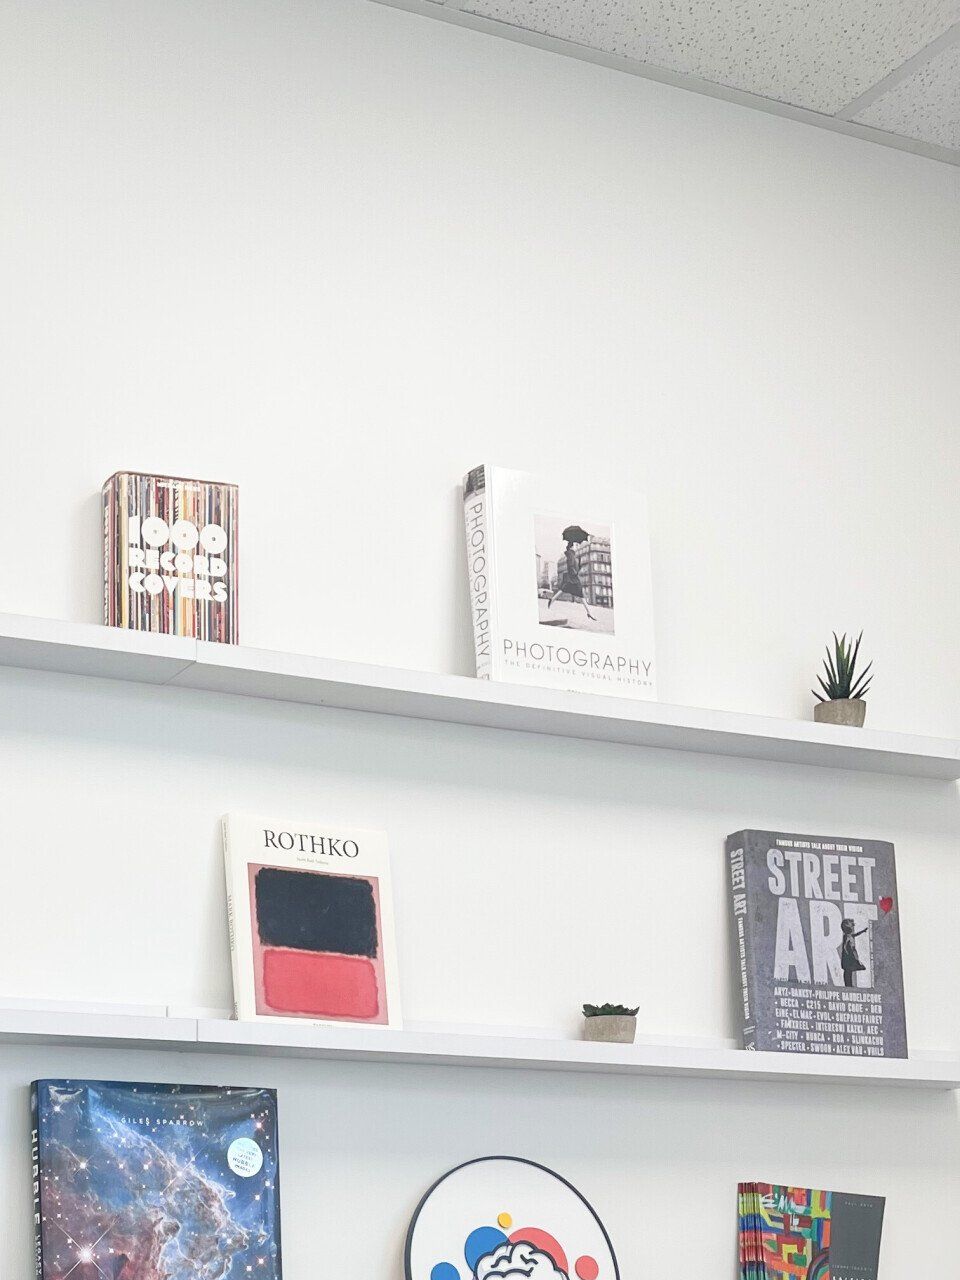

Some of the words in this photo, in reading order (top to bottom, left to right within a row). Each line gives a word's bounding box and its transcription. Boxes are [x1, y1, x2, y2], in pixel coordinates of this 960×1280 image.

[128, 515, 228, 555] 1000
[128, 547, 228, 578] RECORD
[128, 571, 228, 603] COVERS
[469, 502, 491, 657] PHOTOGRAPHY
[503, 638, 652, 677] PHOTOGRAPHY
[504, 659, 521, 668] THE
[525, 662, 577, 676] DEFINITIVE
[581, 671, 612, 681] VISUAL
[617, 676, 653, 687] HISTORY
[263, 829, 359, 858] ROTHKO
[730, 848, 746, 891] STREET
[766, 848, 876, 903] STREET
[733, 893, 748, 916] ART
[773, 896, 879, 989] ART
[805, 999, 821, 1010] C215
[828, 1001, 846, 1012] DAVID
[814, 989, 840, 1001] PHILIPPE
[835, 1012, 863, 1023] SHEPARD
[863, 1014, 883, 1025] FAIREY
[780, 1040, 806, 1051] SPECTER
[120, 1117, 150, 1126] GILES
[156, 1118, 204, 1127] SPARROW
